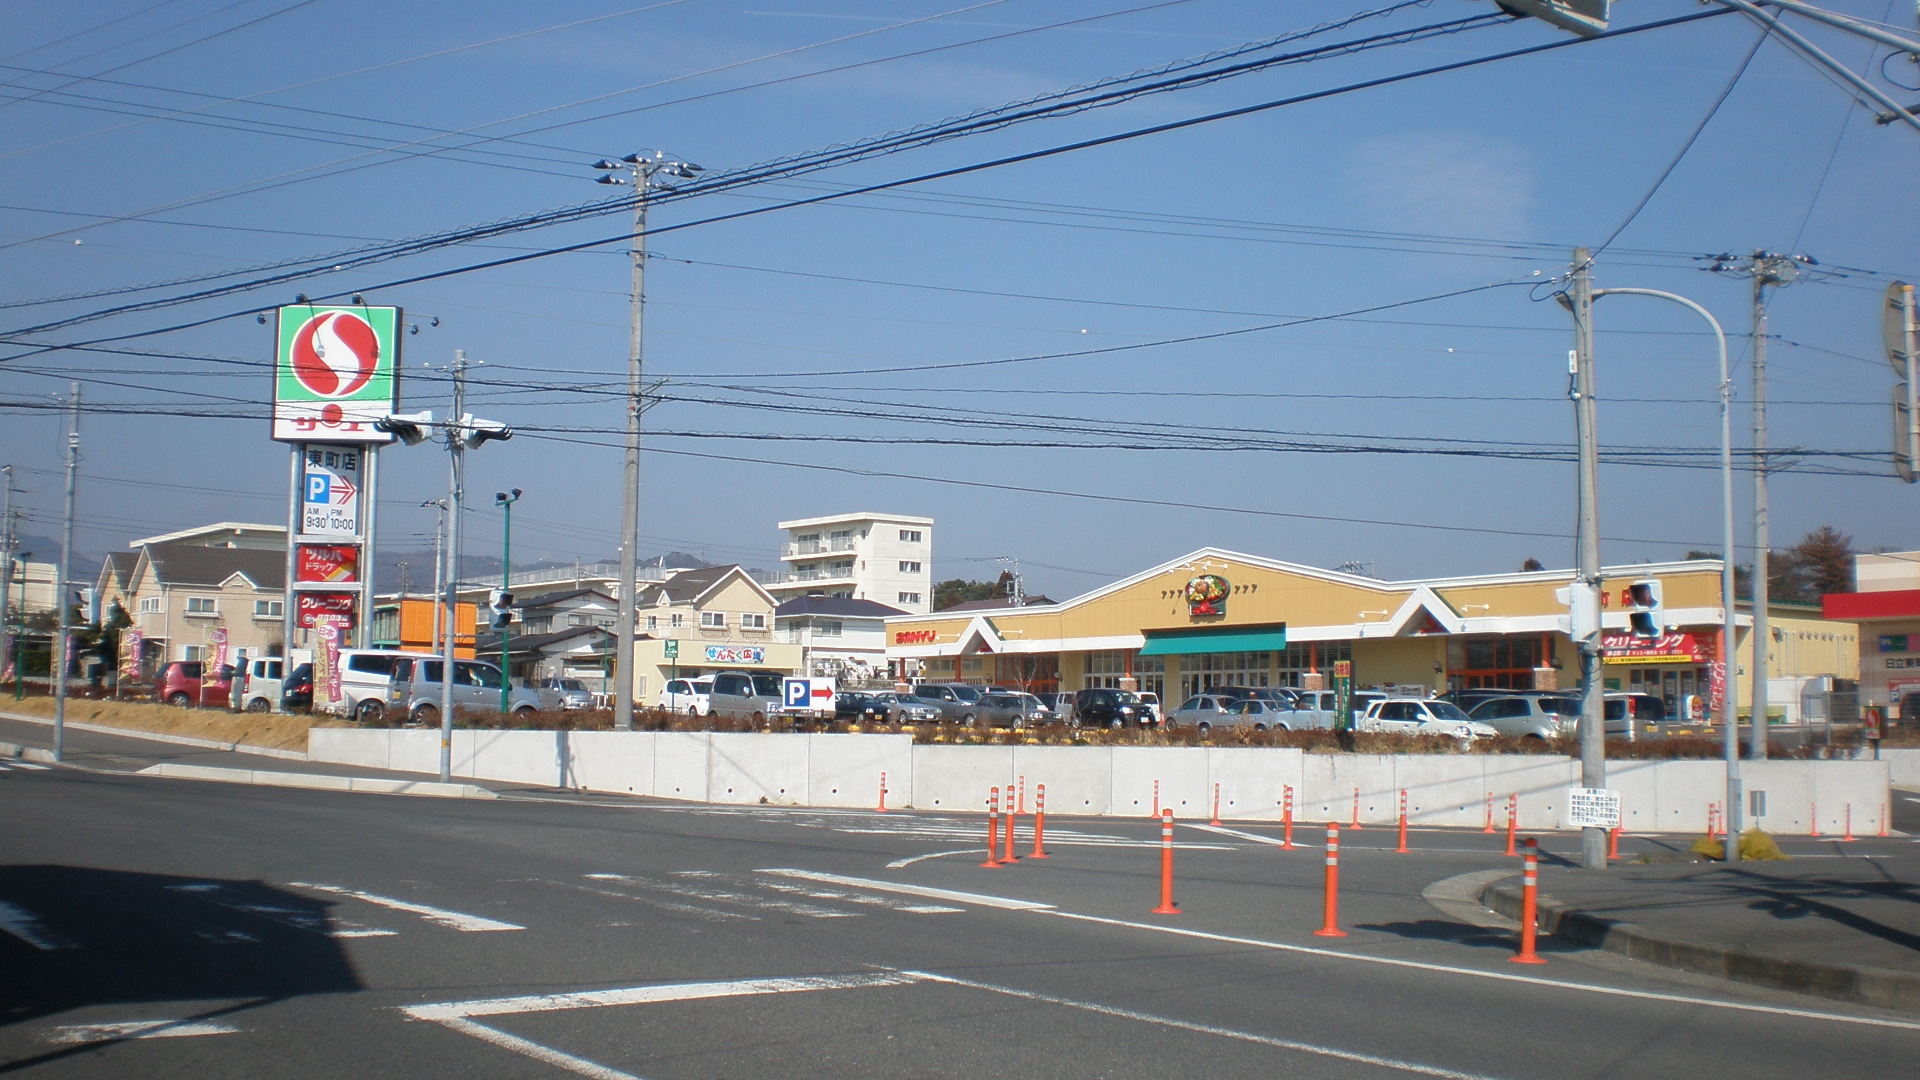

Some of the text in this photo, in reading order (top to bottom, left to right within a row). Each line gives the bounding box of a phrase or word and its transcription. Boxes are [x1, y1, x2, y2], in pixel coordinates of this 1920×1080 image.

[308, 449, 356, 471] 東町店
[310, 477, 325, 500] P
[306, 517, 354, 530] 9:30 10:00
[306, 549, 342, 561] ツルハ
[306, 562, 336, 572] ドラッグ
[302, 597, 352, 610] クリーニング
[790, 683, 805, 704] P
